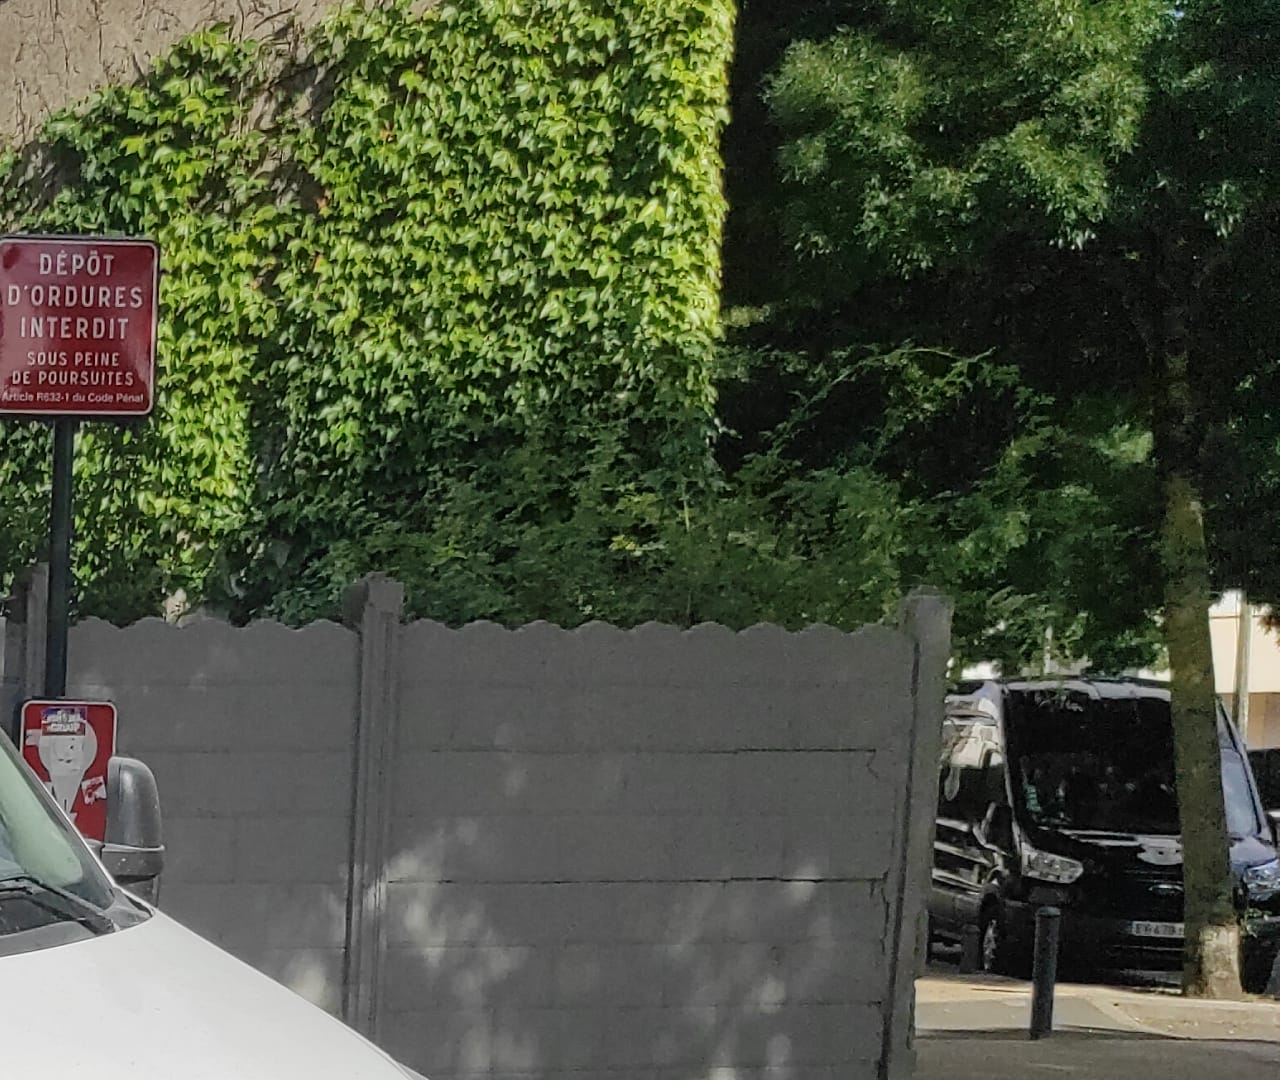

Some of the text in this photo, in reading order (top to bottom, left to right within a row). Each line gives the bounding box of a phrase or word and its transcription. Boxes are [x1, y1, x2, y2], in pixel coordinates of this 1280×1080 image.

[39, 249, 115, 276] DÉPÔT
[7, 284, 143, 308] D'ORDURES
[20, 316, 129, 339] INTERDIT
[27, 351, 120, 367] SOUS PEINE
[12, 370, 134, 386] DE POURSUITES
[1, 391, 34, 402] Article
[72, 393, 86, 402] du
[87, 393, 114, 402] Code
[116, 392, 144, 403] Pénal
